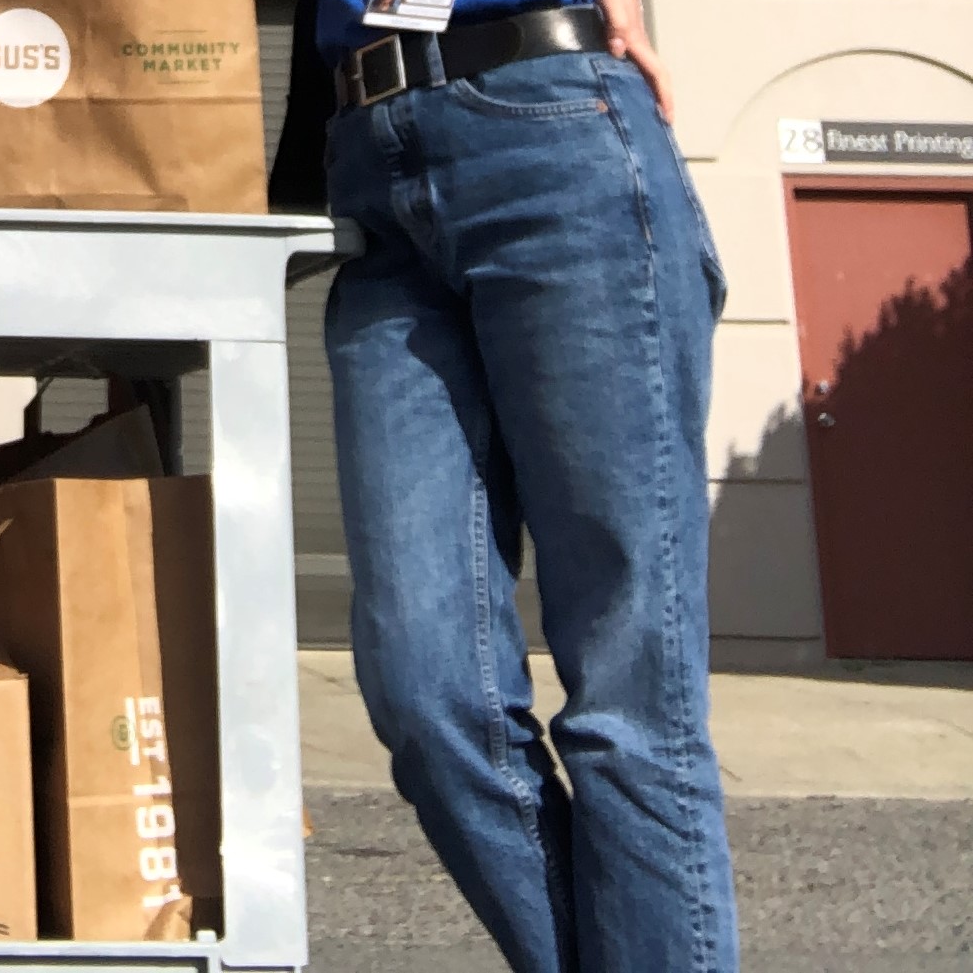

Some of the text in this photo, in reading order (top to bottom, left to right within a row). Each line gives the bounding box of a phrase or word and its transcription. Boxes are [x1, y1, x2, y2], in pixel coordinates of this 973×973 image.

[121, 42, 240, 56] COMMUNITY
[142, 59, 222, 72] MARKET
[132, 696, 183, 907] EST 1981
